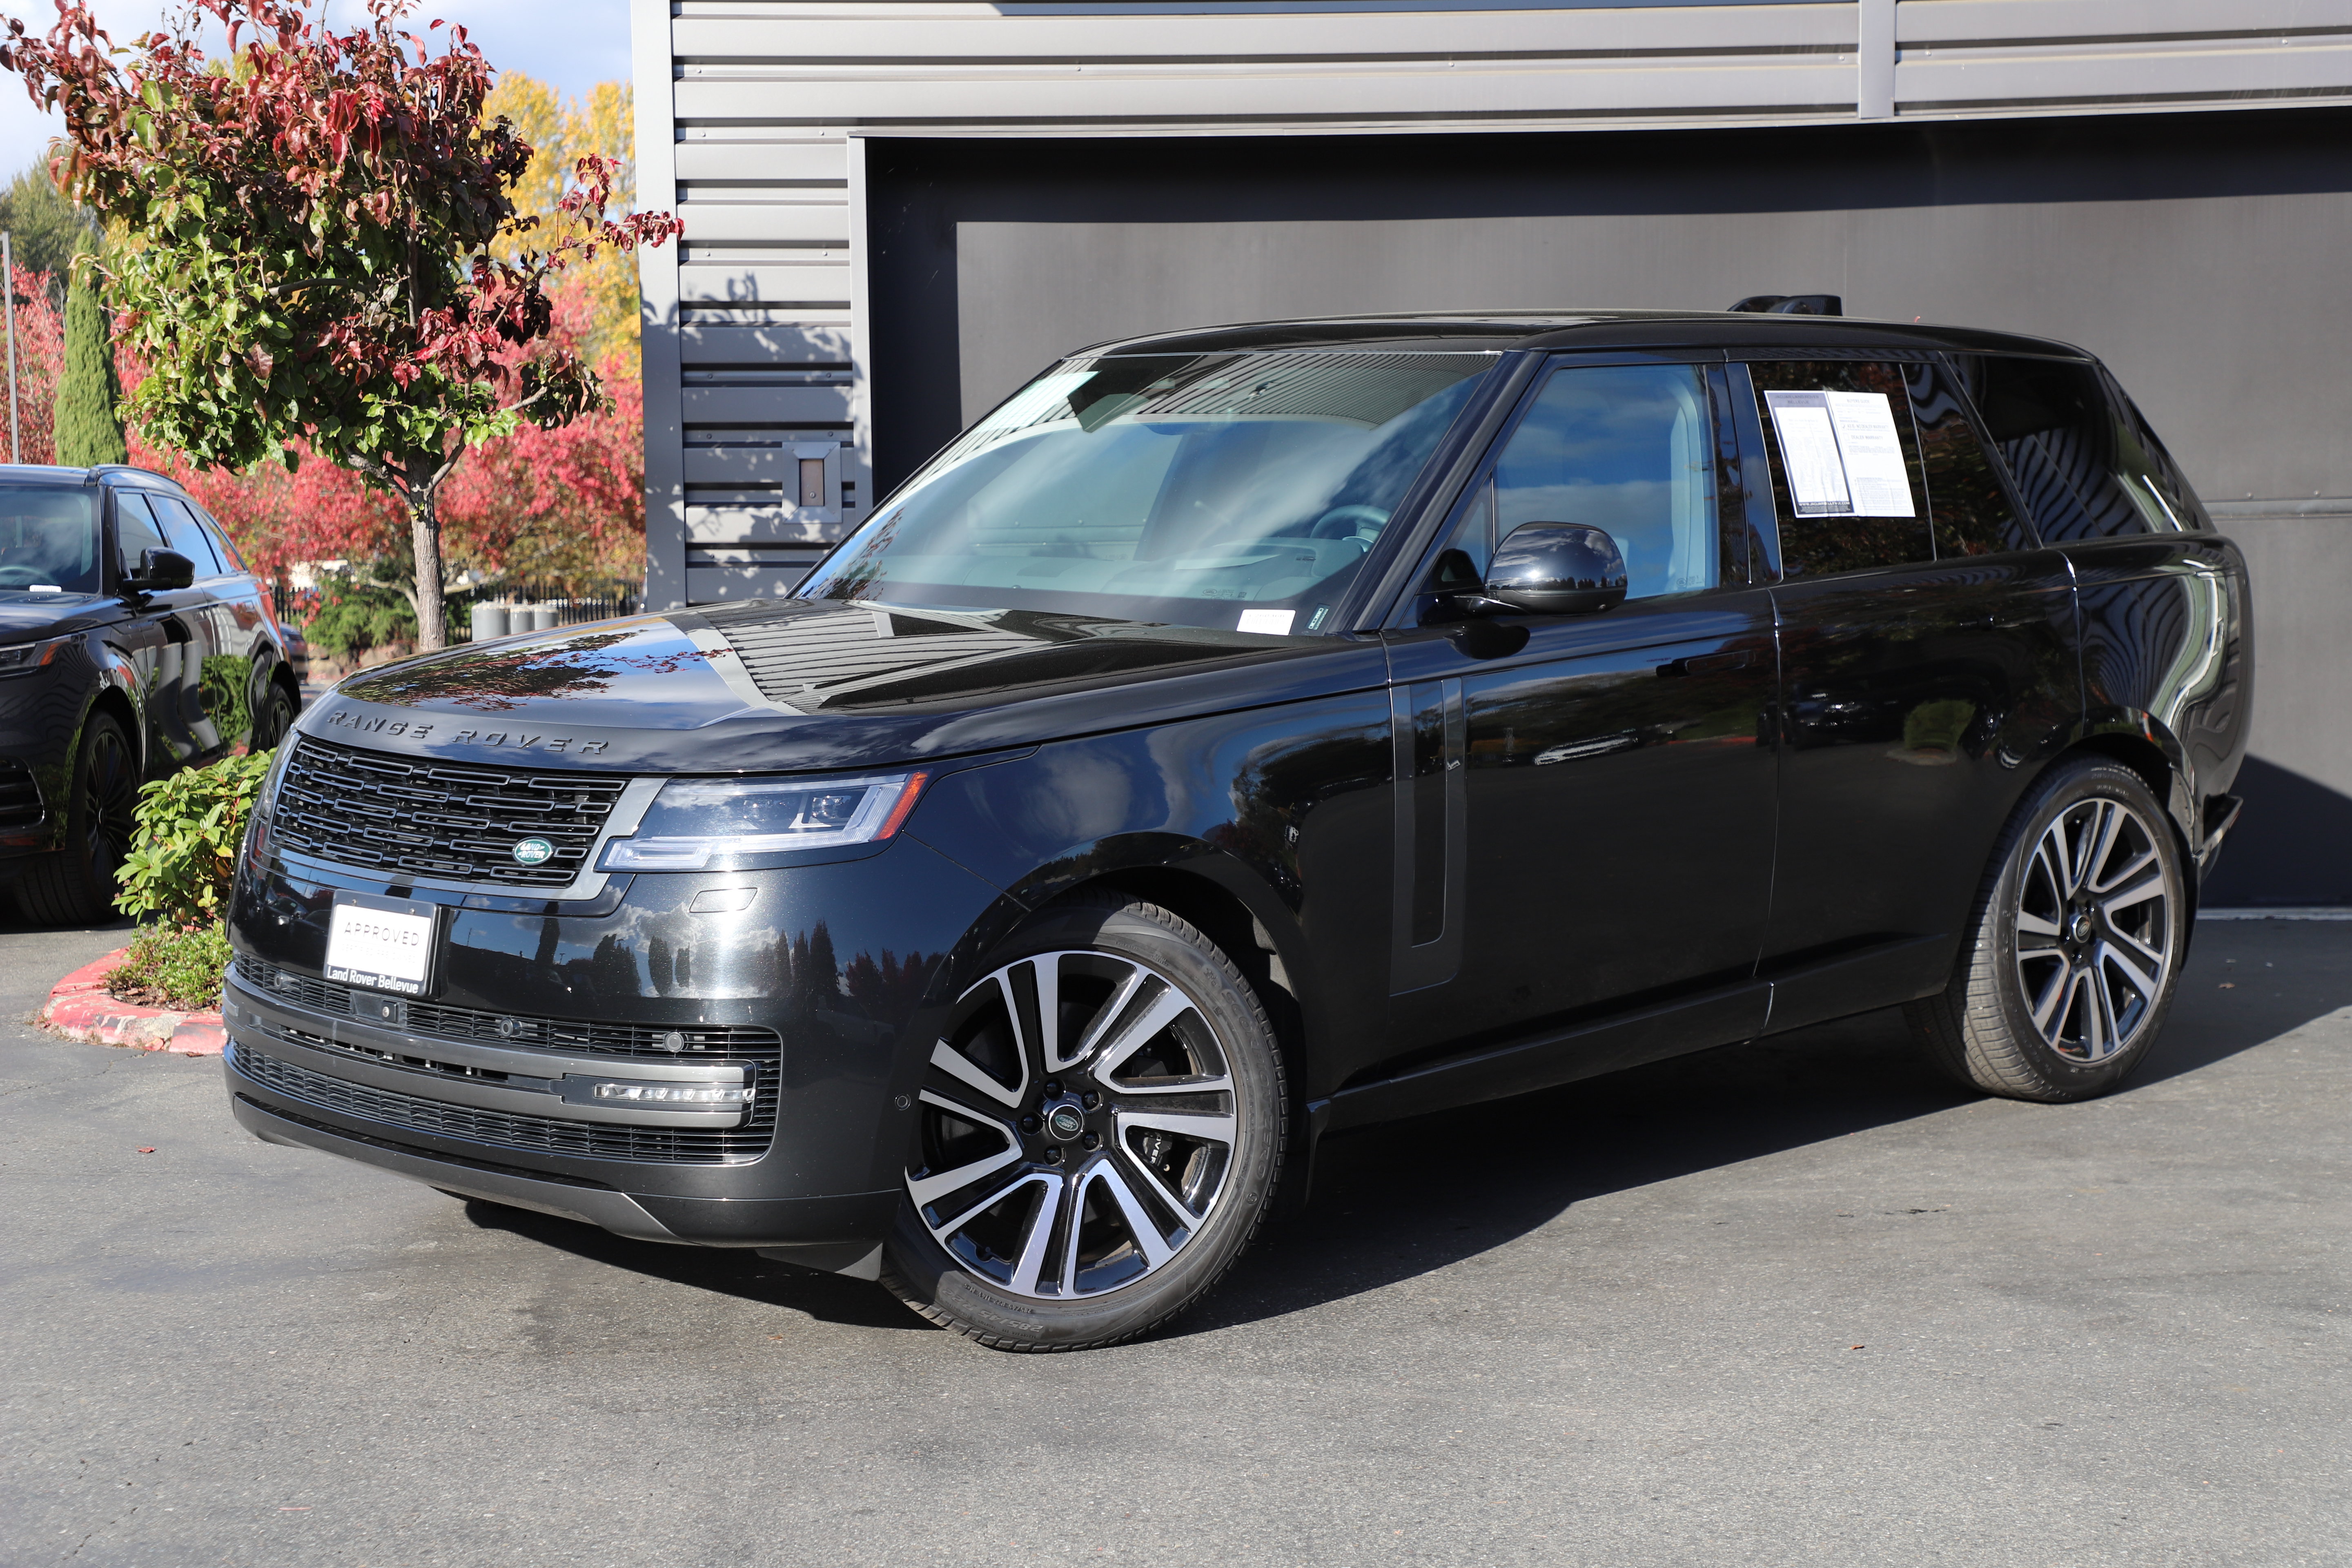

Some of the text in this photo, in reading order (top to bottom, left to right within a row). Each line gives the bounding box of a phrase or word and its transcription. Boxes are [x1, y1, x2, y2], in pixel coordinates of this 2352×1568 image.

[327, 710, 609, 755] RANGE ROVER
[520, 851, 546, 859] ROVER
[344, 922, 419, 946] APPROVED
[327, 966, 419, 994] Land Rover Bellevue
[1221, 989, 1271, 1100] SCORPION
[1257, 1111, 1273, 1179] ZERO
[1059, 1116, 1074, 1125] ROVER
[1009, 1304, 1033, 1314] 285/45
[978, 1310, 1044, 1332] 285/45
